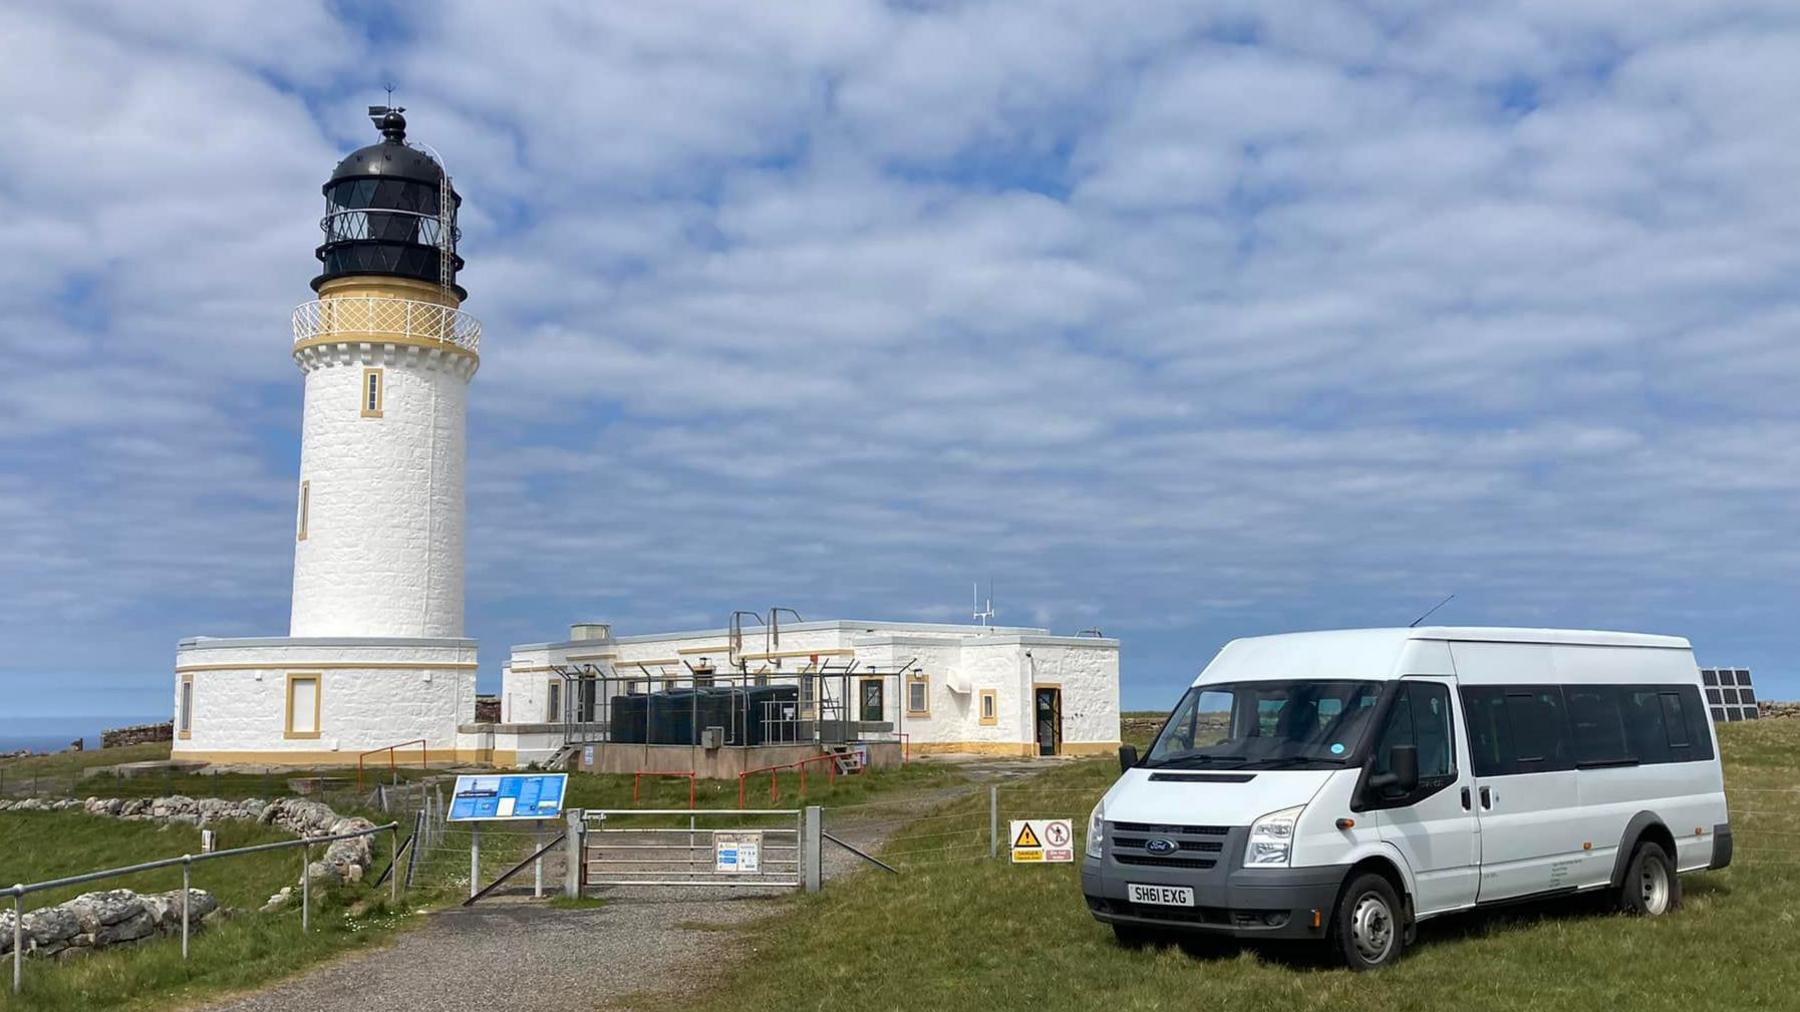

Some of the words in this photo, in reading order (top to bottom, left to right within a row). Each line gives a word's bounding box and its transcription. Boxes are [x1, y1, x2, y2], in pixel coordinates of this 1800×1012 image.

[1150, 840, 1167, 850] Ford
[1135, 886, 1160, 902] SH61
[1163, 887, 1187, 904] EXG
